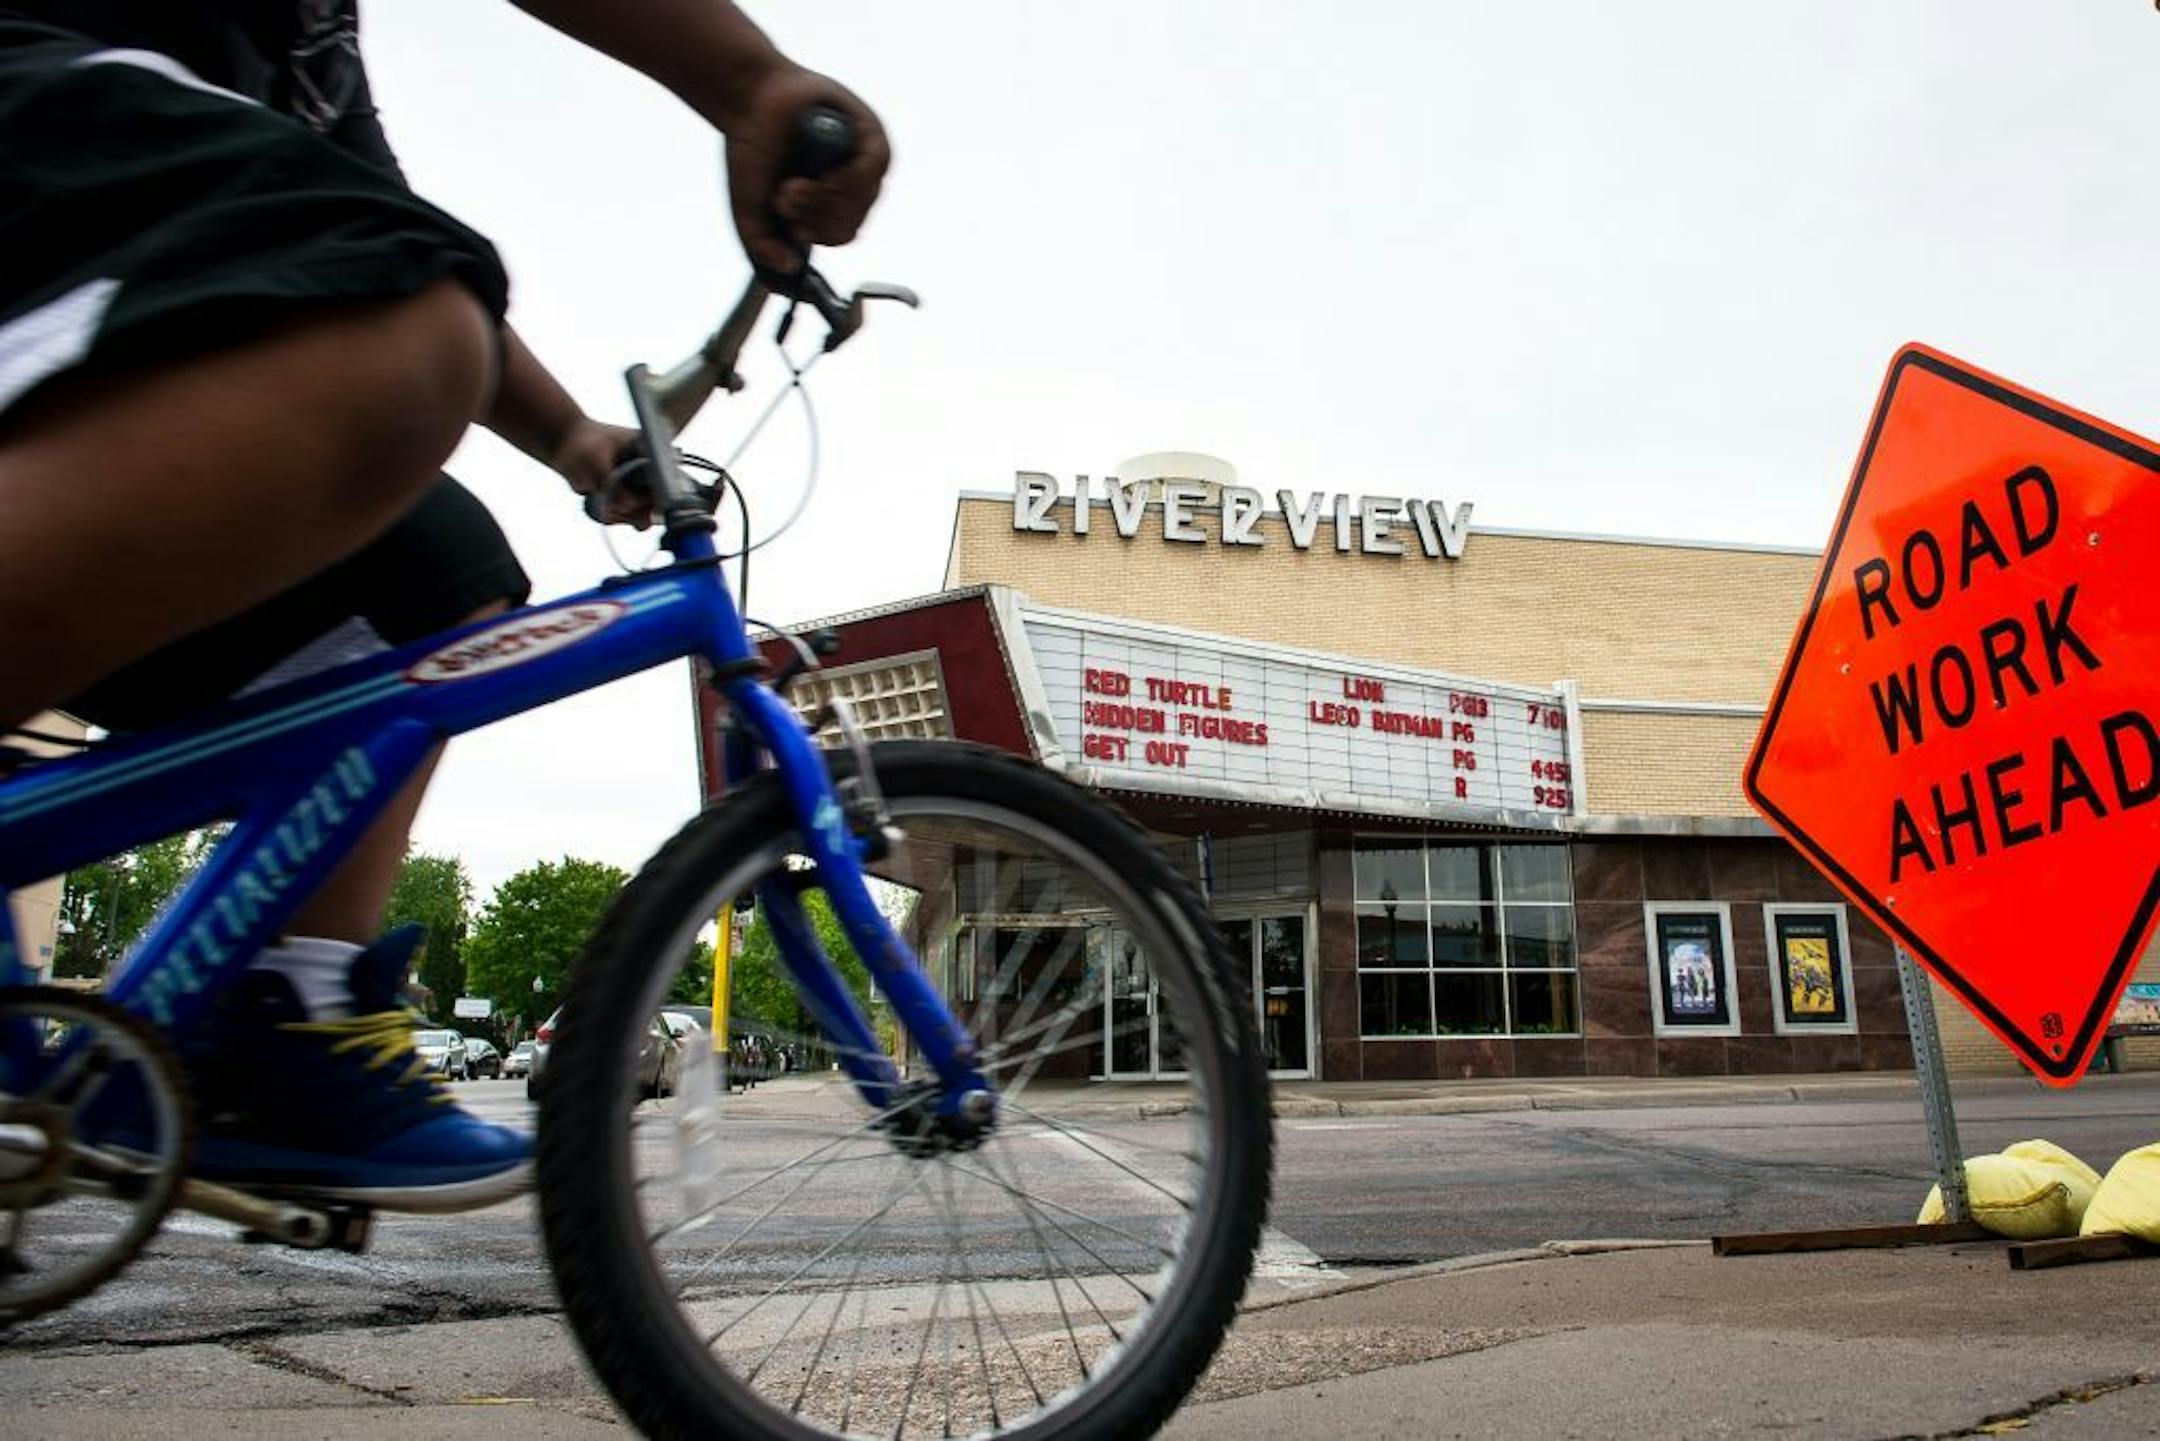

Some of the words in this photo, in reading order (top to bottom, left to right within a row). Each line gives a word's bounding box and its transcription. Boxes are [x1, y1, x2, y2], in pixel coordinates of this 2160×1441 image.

[1013, 470, 1475, 559] RIVERVIEW
[1854, 465, 2060, 640] ROAD
[1085, 668, 1130, 697] RED
[1146, 677, 1232, 711] TURTLE
[1343, 676, 1384, 703] LION
[1870, 584, 2103, 756] WORK
[1084, 701, 1165, 734] HIDDEN
[1179, 713, 1269, 746] FIGURES
[1310, 700, 1360, 728] LEGO
[1373, 710, 1443, 739] BATMAN
[1452, 721, 1475, 743] PG
[1084, 733, 1130, 762] GET
[1146, 741, 1190, 768] OUT
[1453, 749, 1476, 771] PG
[1455, 776, 1467, 799] R
[1890, 709, 2160, 884] AHEAD
